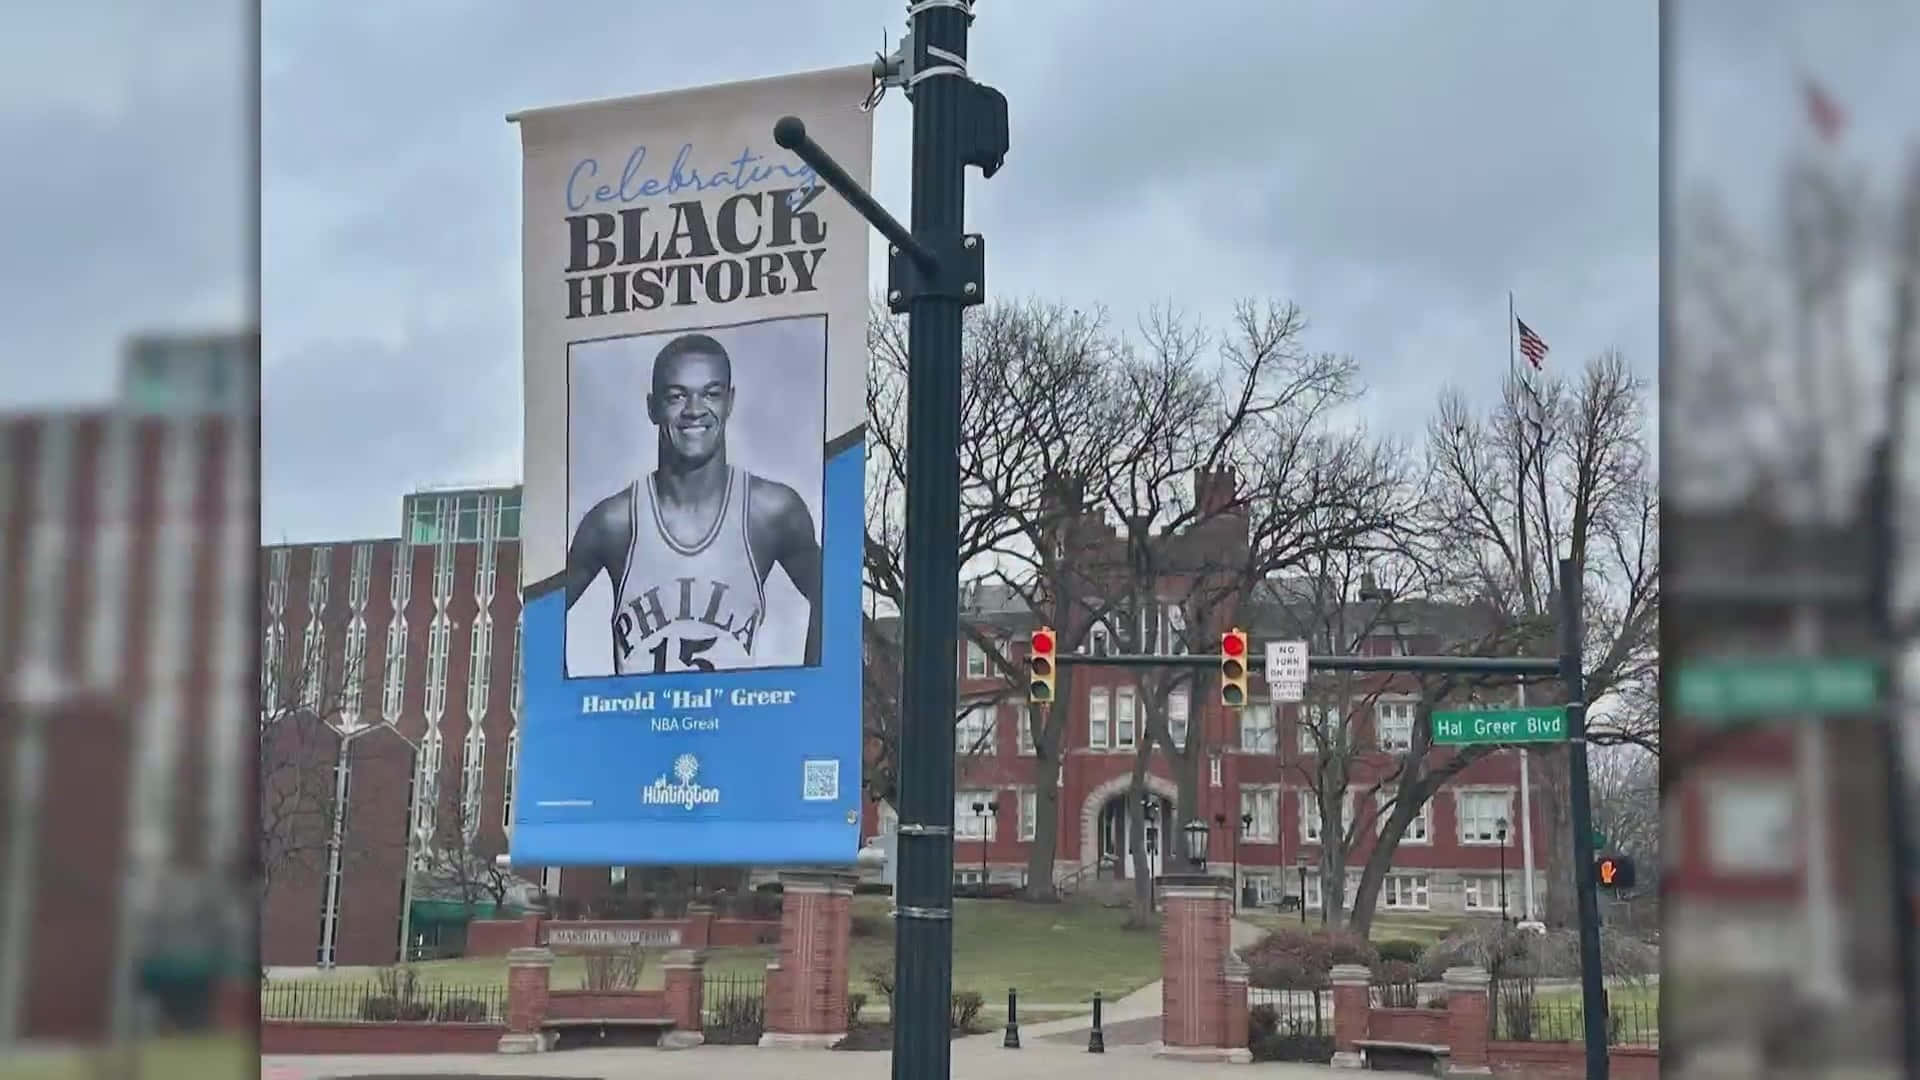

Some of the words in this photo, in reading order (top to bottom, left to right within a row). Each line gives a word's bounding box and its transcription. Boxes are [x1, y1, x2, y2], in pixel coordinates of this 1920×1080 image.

[566, 144, 817, 211] Celebrating
[564, 185, 827, 273] BLACK
[565, 249, 826, 319] HISTORY
[614, 578, 760, 659] PHILA
[649, 637, 717, 672] 15
[1276, 656, 1299, 666] TURN
[1271, 669, 1283, 677] ON
[582, 691, 655, 713] Harold
[731, 688, 796, 706] Greer
[651, 717, 679, 731] NBA
[682, 717, 719, 730] Great
[1438, 720, 1462, 736] Hal
[1474, 719, 1517, 735] Greer
[1527, 717, 1561, 733] Blvd
[643, 784, 719, 810] Huntington
